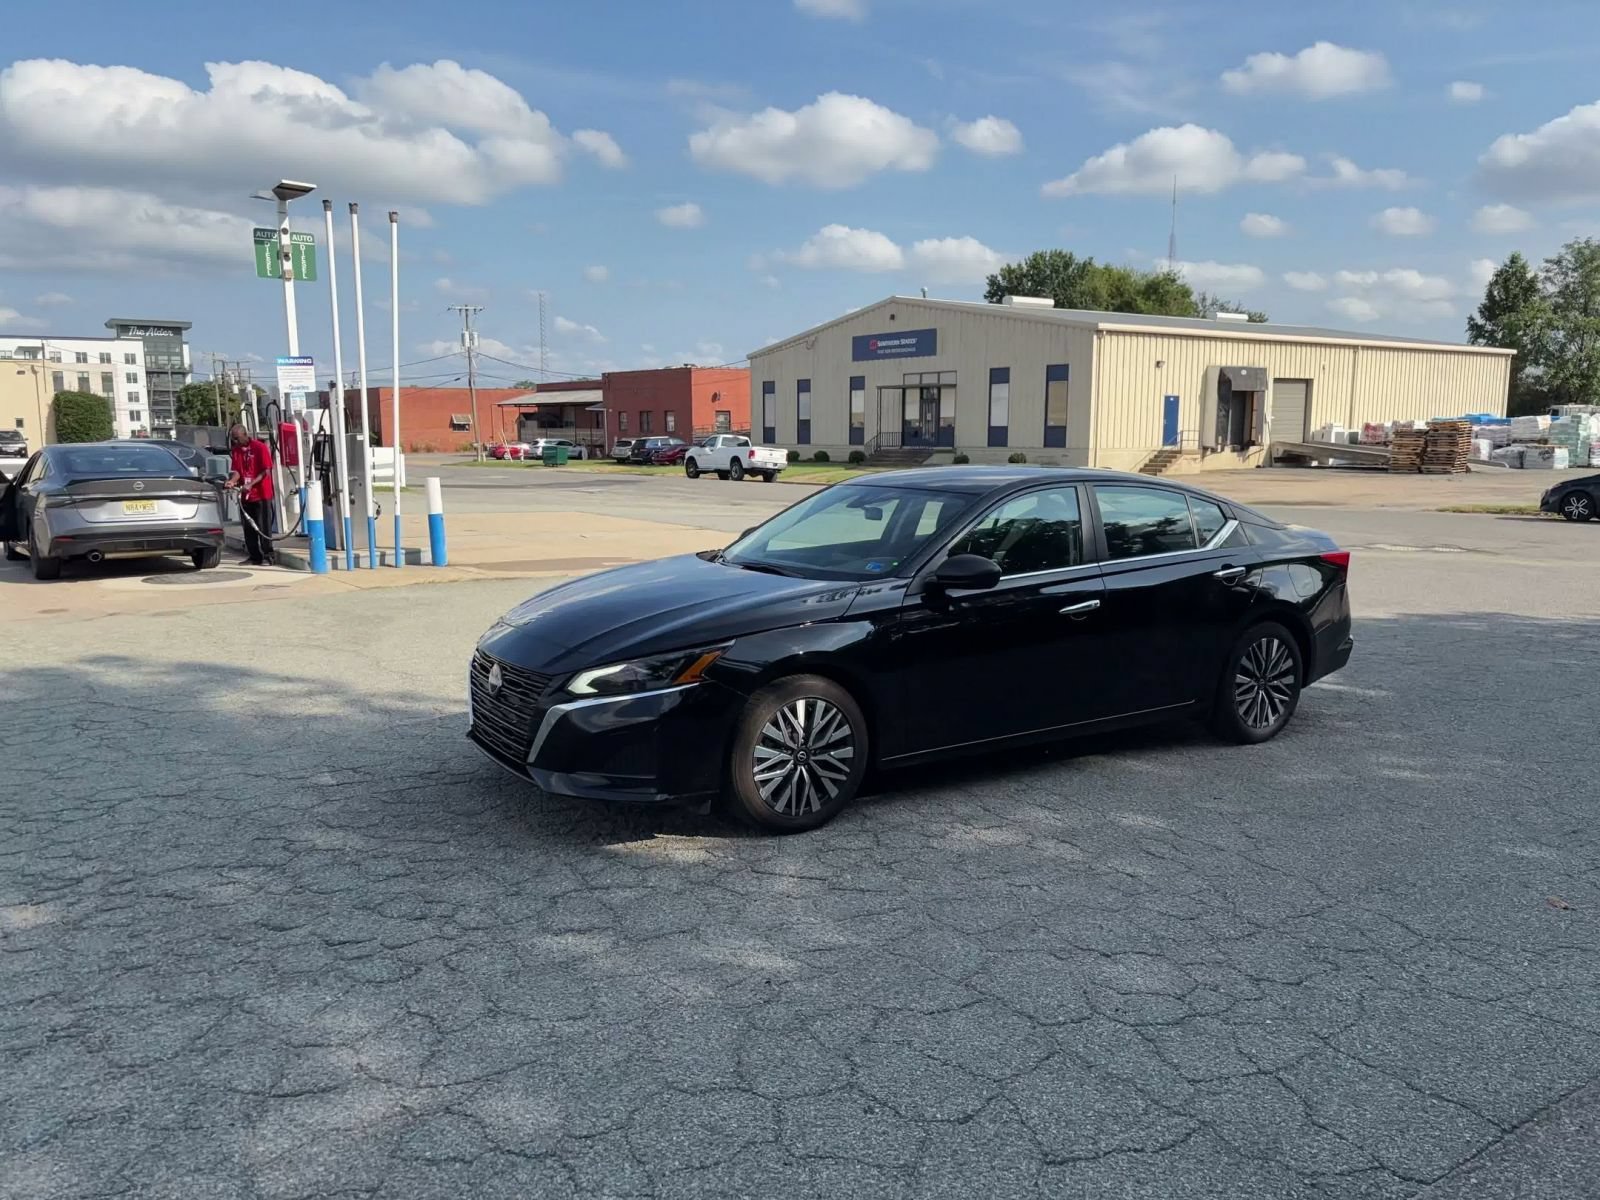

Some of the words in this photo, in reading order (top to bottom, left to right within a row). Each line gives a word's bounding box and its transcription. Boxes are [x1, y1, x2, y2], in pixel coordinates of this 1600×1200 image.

[255, 231, 278, 239] AUTO
[292, 234, 313, 242] AUTO
[264, 241, 273, 277] DIESEL
[299, 244, 308, 279] DIESEL
[128, 326, 145, 336] The
[145, 327, 174, 337] Alder
